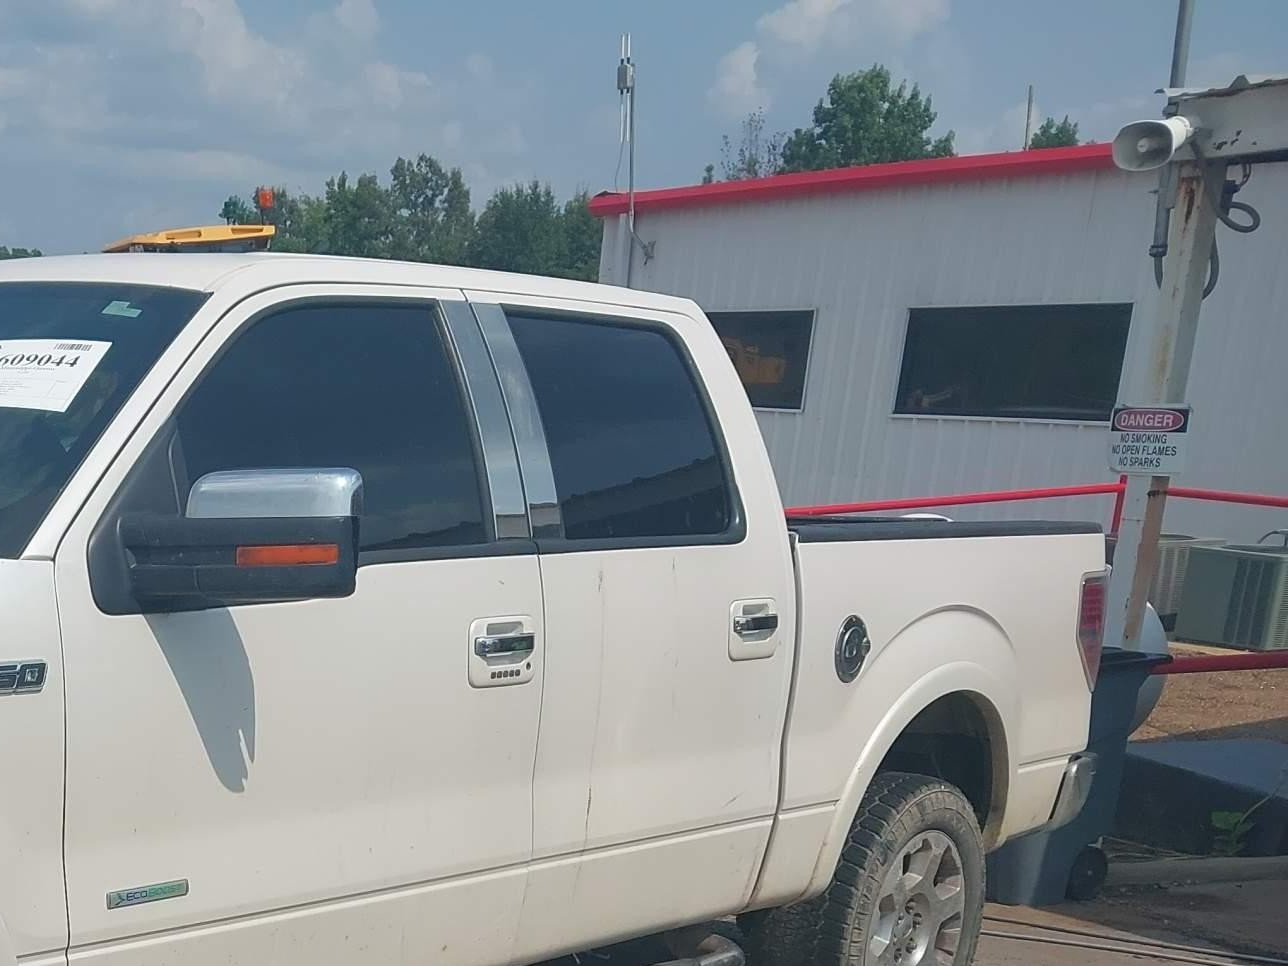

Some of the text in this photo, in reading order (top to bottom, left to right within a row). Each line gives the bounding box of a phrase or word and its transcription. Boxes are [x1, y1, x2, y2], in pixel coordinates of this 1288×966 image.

[1120, 414, 1174, 427] DANGER
[1120, 433, 1167, 444] NO SMOKING
[1112, 445, 1177, 457] NO OPEN FLAMES
[1118, 457, 1161, 468] NO SPARKS
